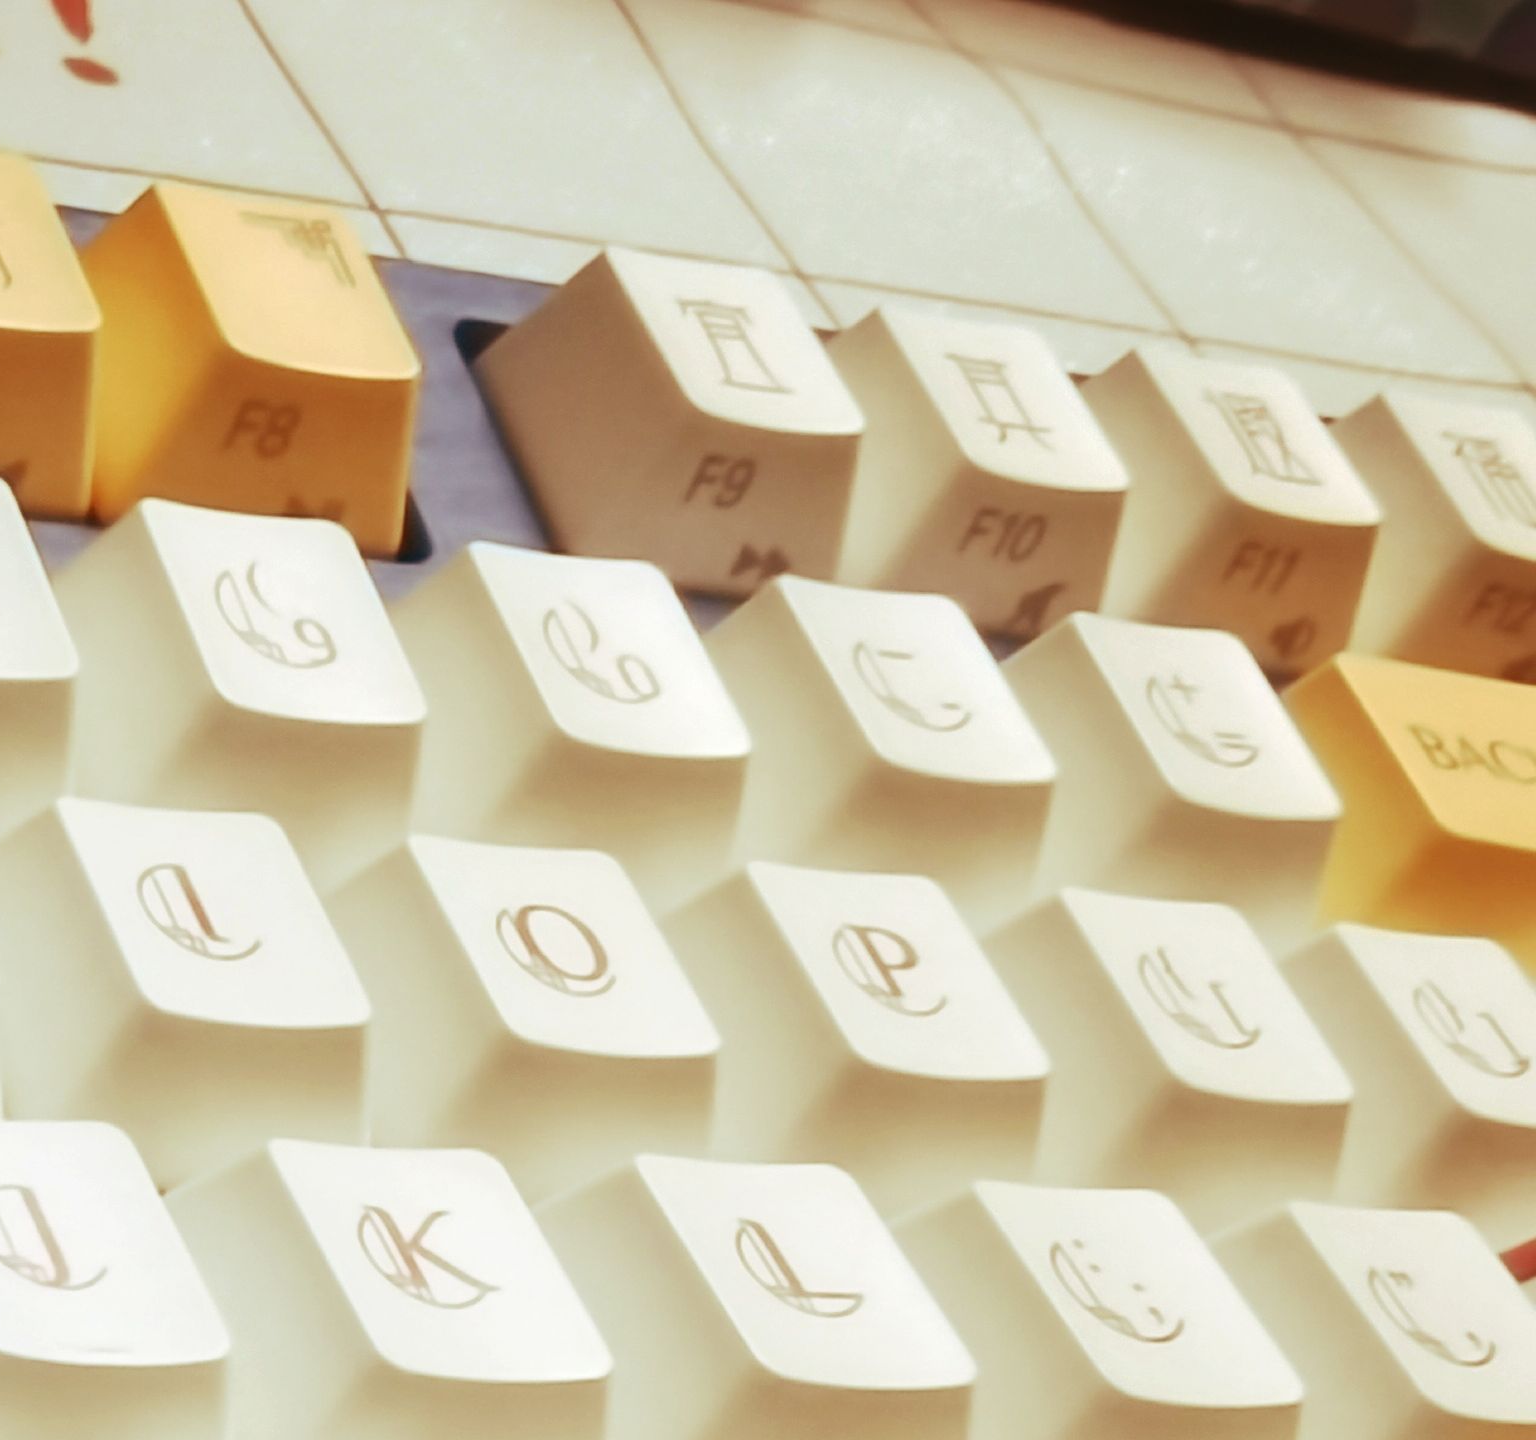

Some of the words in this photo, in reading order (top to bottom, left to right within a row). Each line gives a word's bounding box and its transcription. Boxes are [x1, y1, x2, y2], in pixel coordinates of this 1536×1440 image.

[220, 398, 302, 460] F8
[682, 453, 758, 510] F9
[956, 507, 1050, 564] F10
[1220, 540, 1302, 596] F11
[293, 617, 338, 668] 9
[513, 903, 611, 985] O
[843, 922, 919, 1000] P
[362, 1203, 504, 1293] K
[736, 1217, 865, 1302] L
